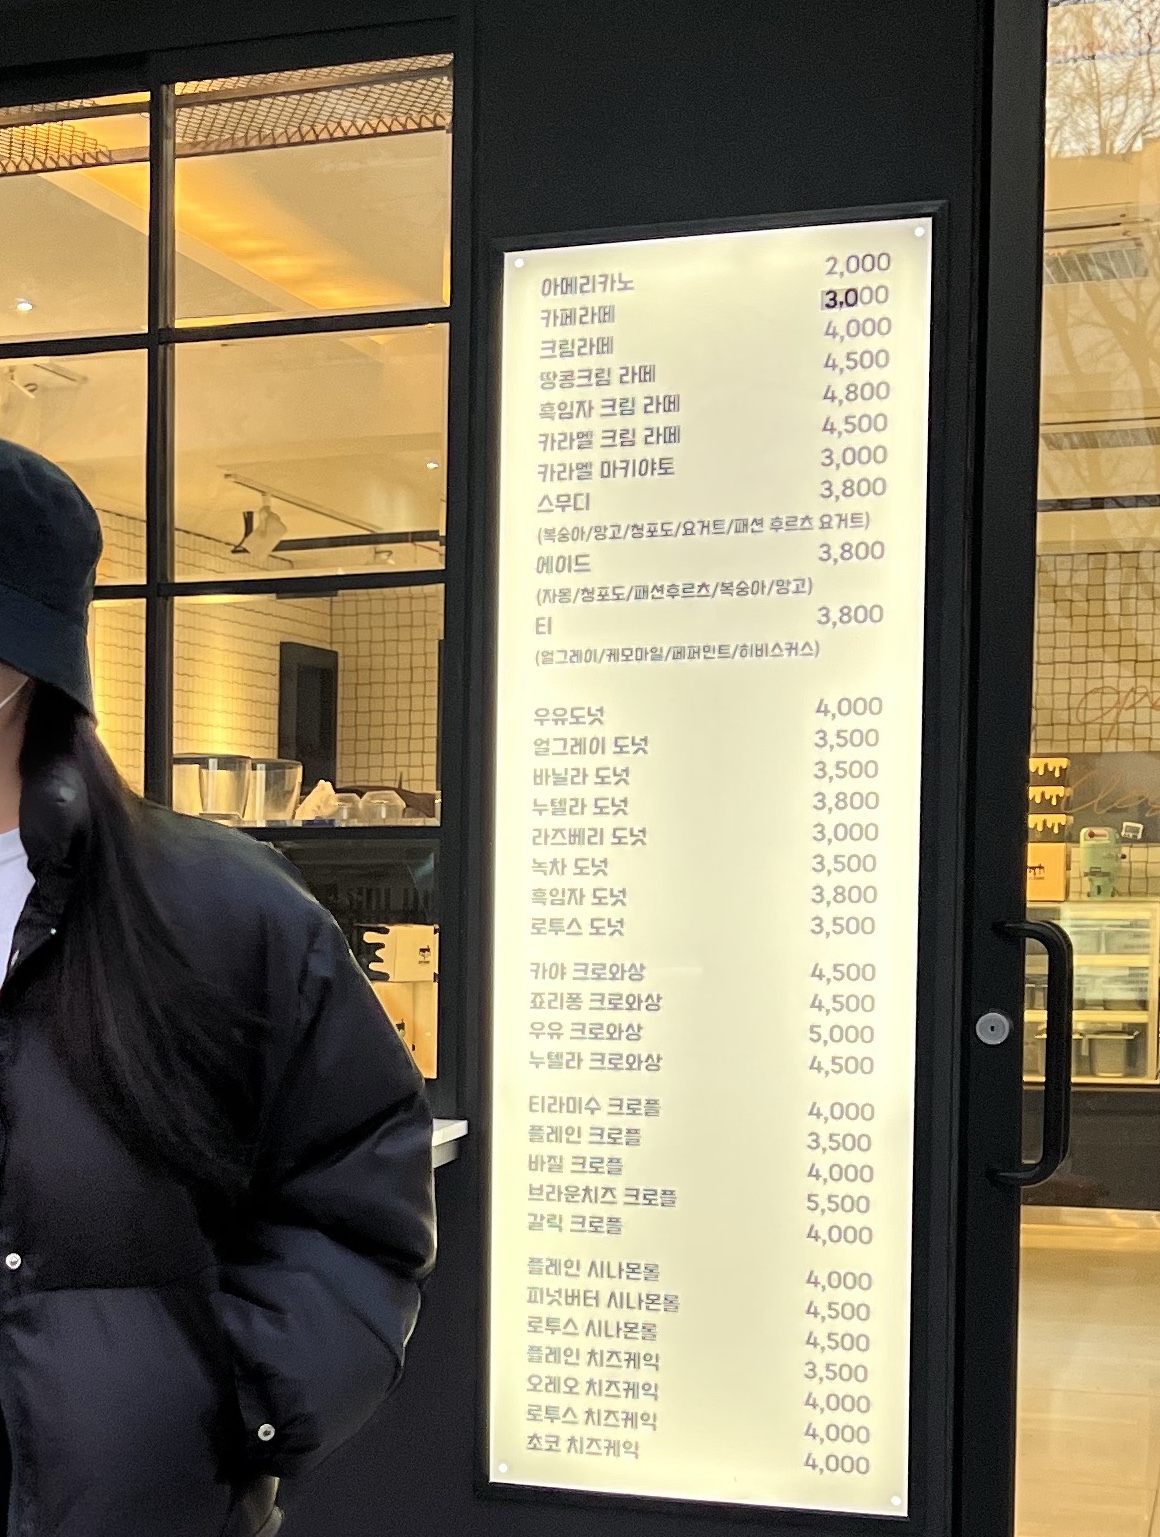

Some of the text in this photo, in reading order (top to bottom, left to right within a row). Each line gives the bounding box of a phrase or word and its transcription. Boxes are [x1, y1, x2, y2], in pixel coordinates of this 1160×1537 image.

[542, 252, 891, 296] 아메리카노 2,000
[541, 284, 889, 328] 카페라떼 3,000
[540, 317, 892, 359] 크림라떼 4,000
[540, 348, 890, 390] 땅콩크림 라떼 4,500
[539, 381, 890, 421] 흑임자 크림 라떼 4,800
[538, 413, 888, 452] 카라멜 크림 라떼 4,500
[538, 445, 888, 482] 카라멜 마키야토 3,000
[537, 477, 887, 513] 스무디 3,800
[770, 515, 813, 532] 후르츠
[819, 511, 870, 530] 요거트)
[536, 540, 885, 574] 에이드 3,800
[535, 604, 884, 635] 티 3,800
[534, 697, 883, 726] 우유도넛 4,000
[534, 728, 879, 756] 얼그레이 도넛 3,500
[533, 760, 878, 786] 바닐라 도넛 3,500
[532, 791, 879, 816] 누텔라 도넛 3,800
[532, 822, 879, 846] 라즈베리 도넛 3,000
[532, 854, 876, 876] 녹차 도넛 3,500
[532, 885, 877, 907] 흑임자 도넛 3,800
[531, 916, 875, 939] 로투스 도넛 3,500
[530, 962, 876, 985] 카야 크로와상 4,500
[589, 993, 663, 1012] 크로와상
[810, 994, 875, 1016] 4,500
[529, 1022, 874, 1047] 우유 크로와상 5,000
[529, 1051, 874, 1078] 누텔라 크로와상 4,500
[529, 1095, 875, 1124] 티라미수 크로플 4,000
[528, 1125, 872, 1154] 플레인 크로플 3,500
[570, 1156, 623, 1175] 크로플
[807, 1163, 874, 1185] 4,000
[528, 1184, 870, 1216] 브라운치즈 크로플 5,500
[570, 1215, 622, 1235] 크로플
[806, 1224, 873, 1246] 4,000
[527, 1257, 872, 1292] 플레인 시나몬롤 4,000
[527, 1286, 870, 1323] 피넛버터 시나몬롤 4,500
[527, 1316, 870, 1353] 로투스 시나몬롤 4,500
[527, 1345, 868, 1384] 플레인 치즈케익 3,500
[527, 1374, 871, 1414] 오레오 치즈케익 4,000
[527, 1404, 870, 1444] 로투스 치즈케익 4,000
[527, 1433, 870, 1475] 초코 치즈케익 4,000
